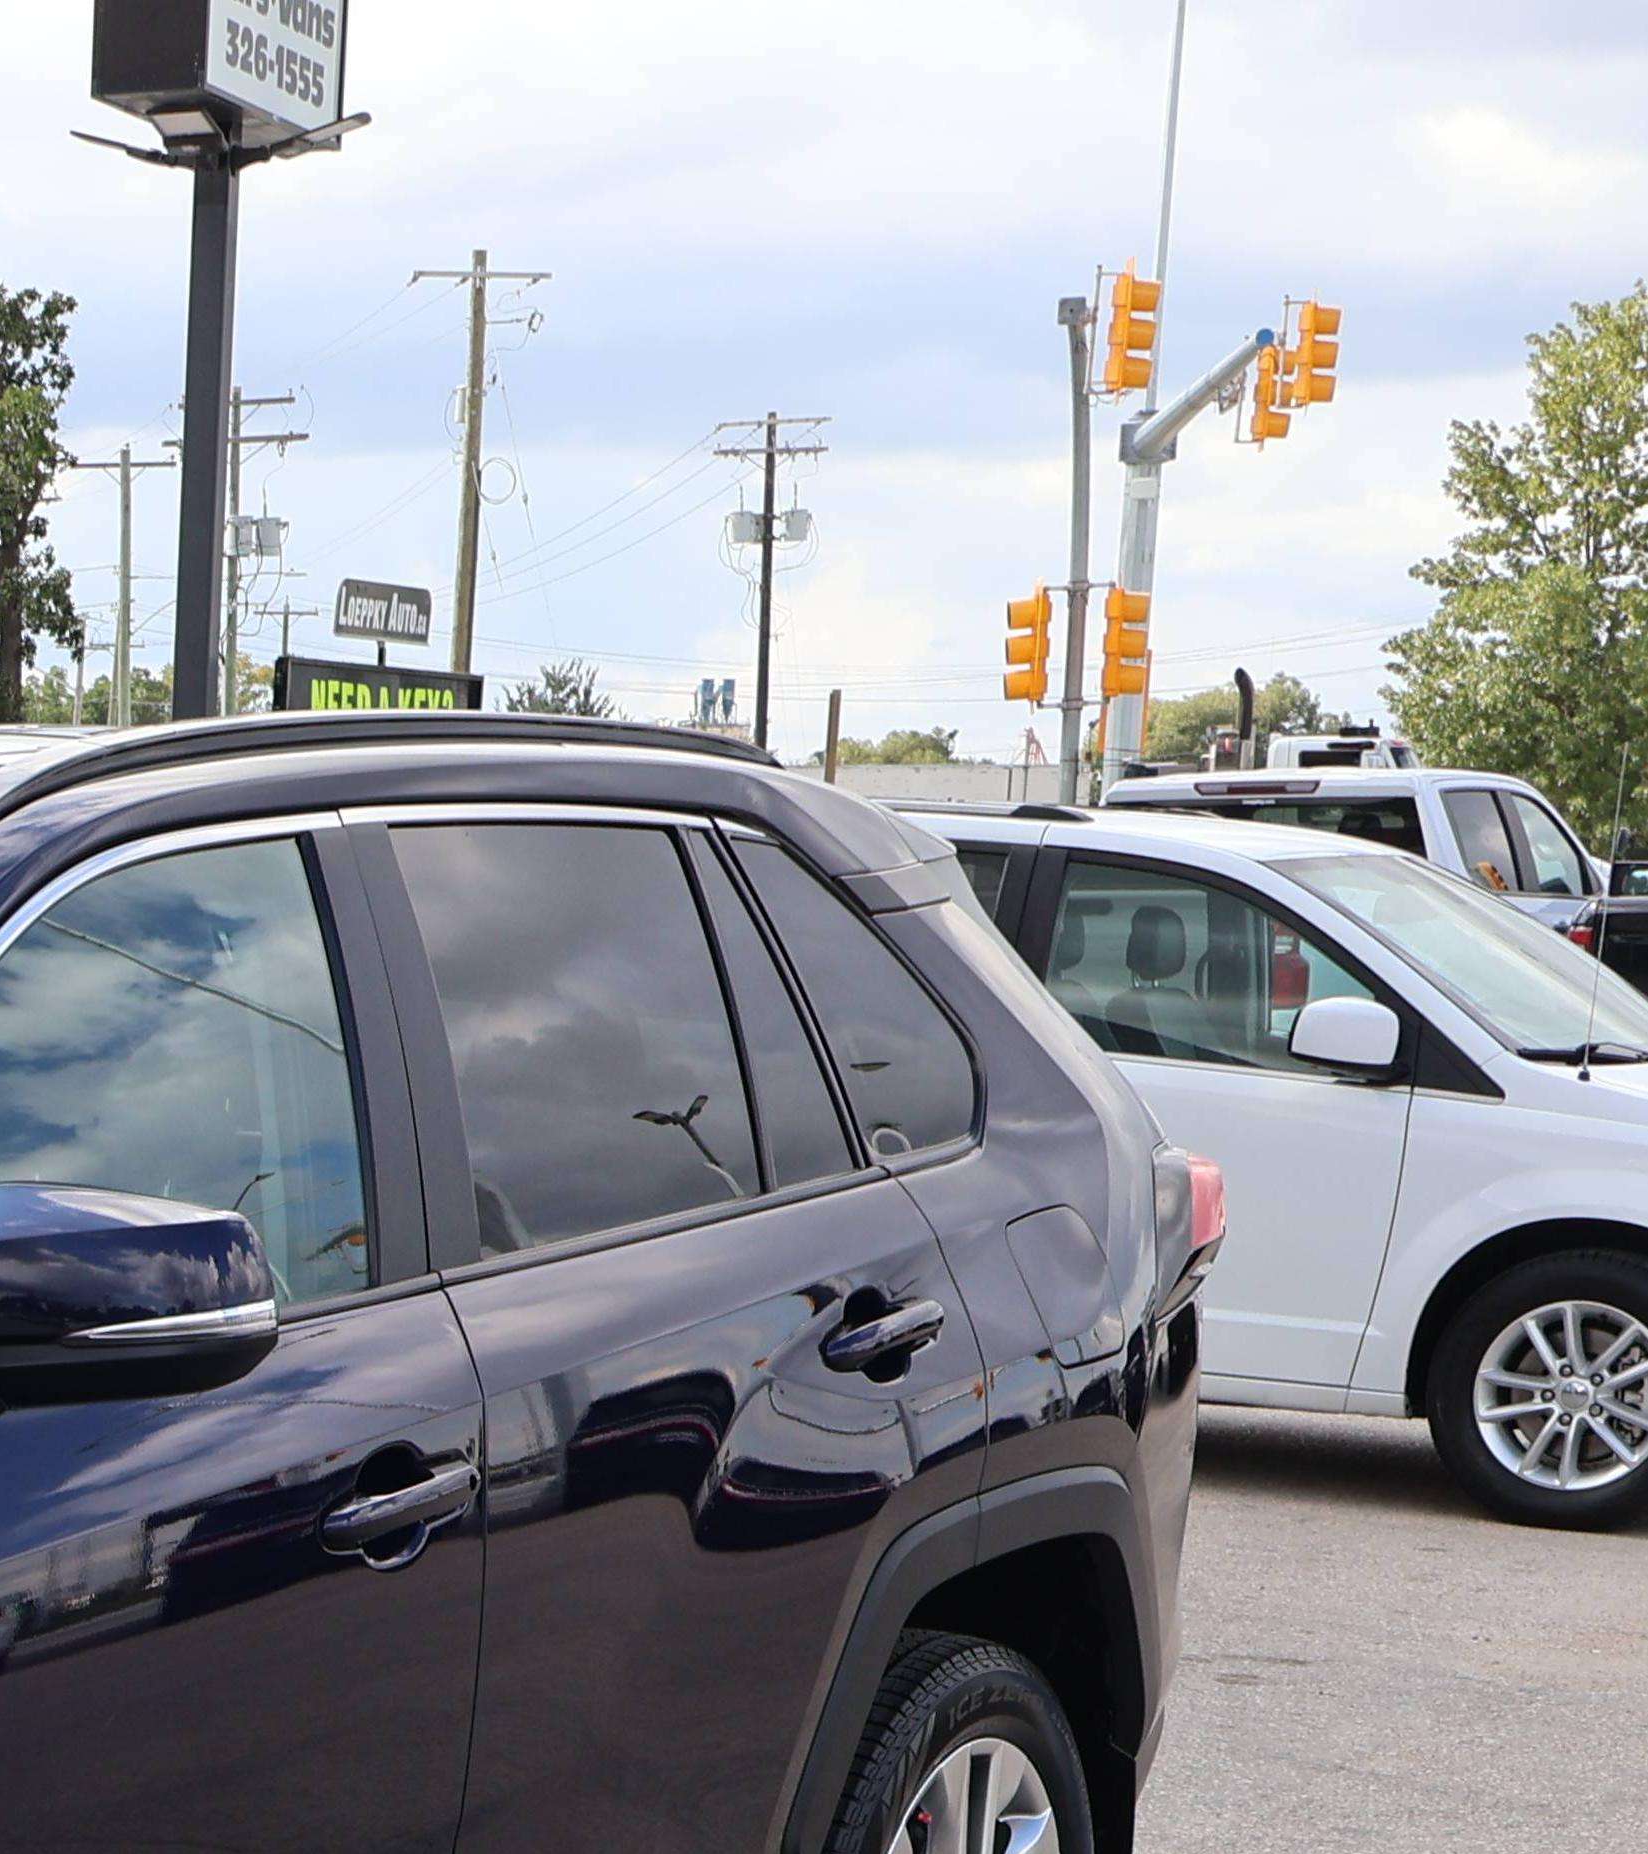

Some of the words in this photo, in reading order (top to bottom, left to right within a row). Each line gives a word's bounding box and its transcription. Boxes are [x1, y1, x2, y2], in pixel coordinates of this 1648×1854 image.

[225, 18, 325, 108] 326-1555
[311, 678, 374, 710] NEED
[379, 686, 390, 710] A
